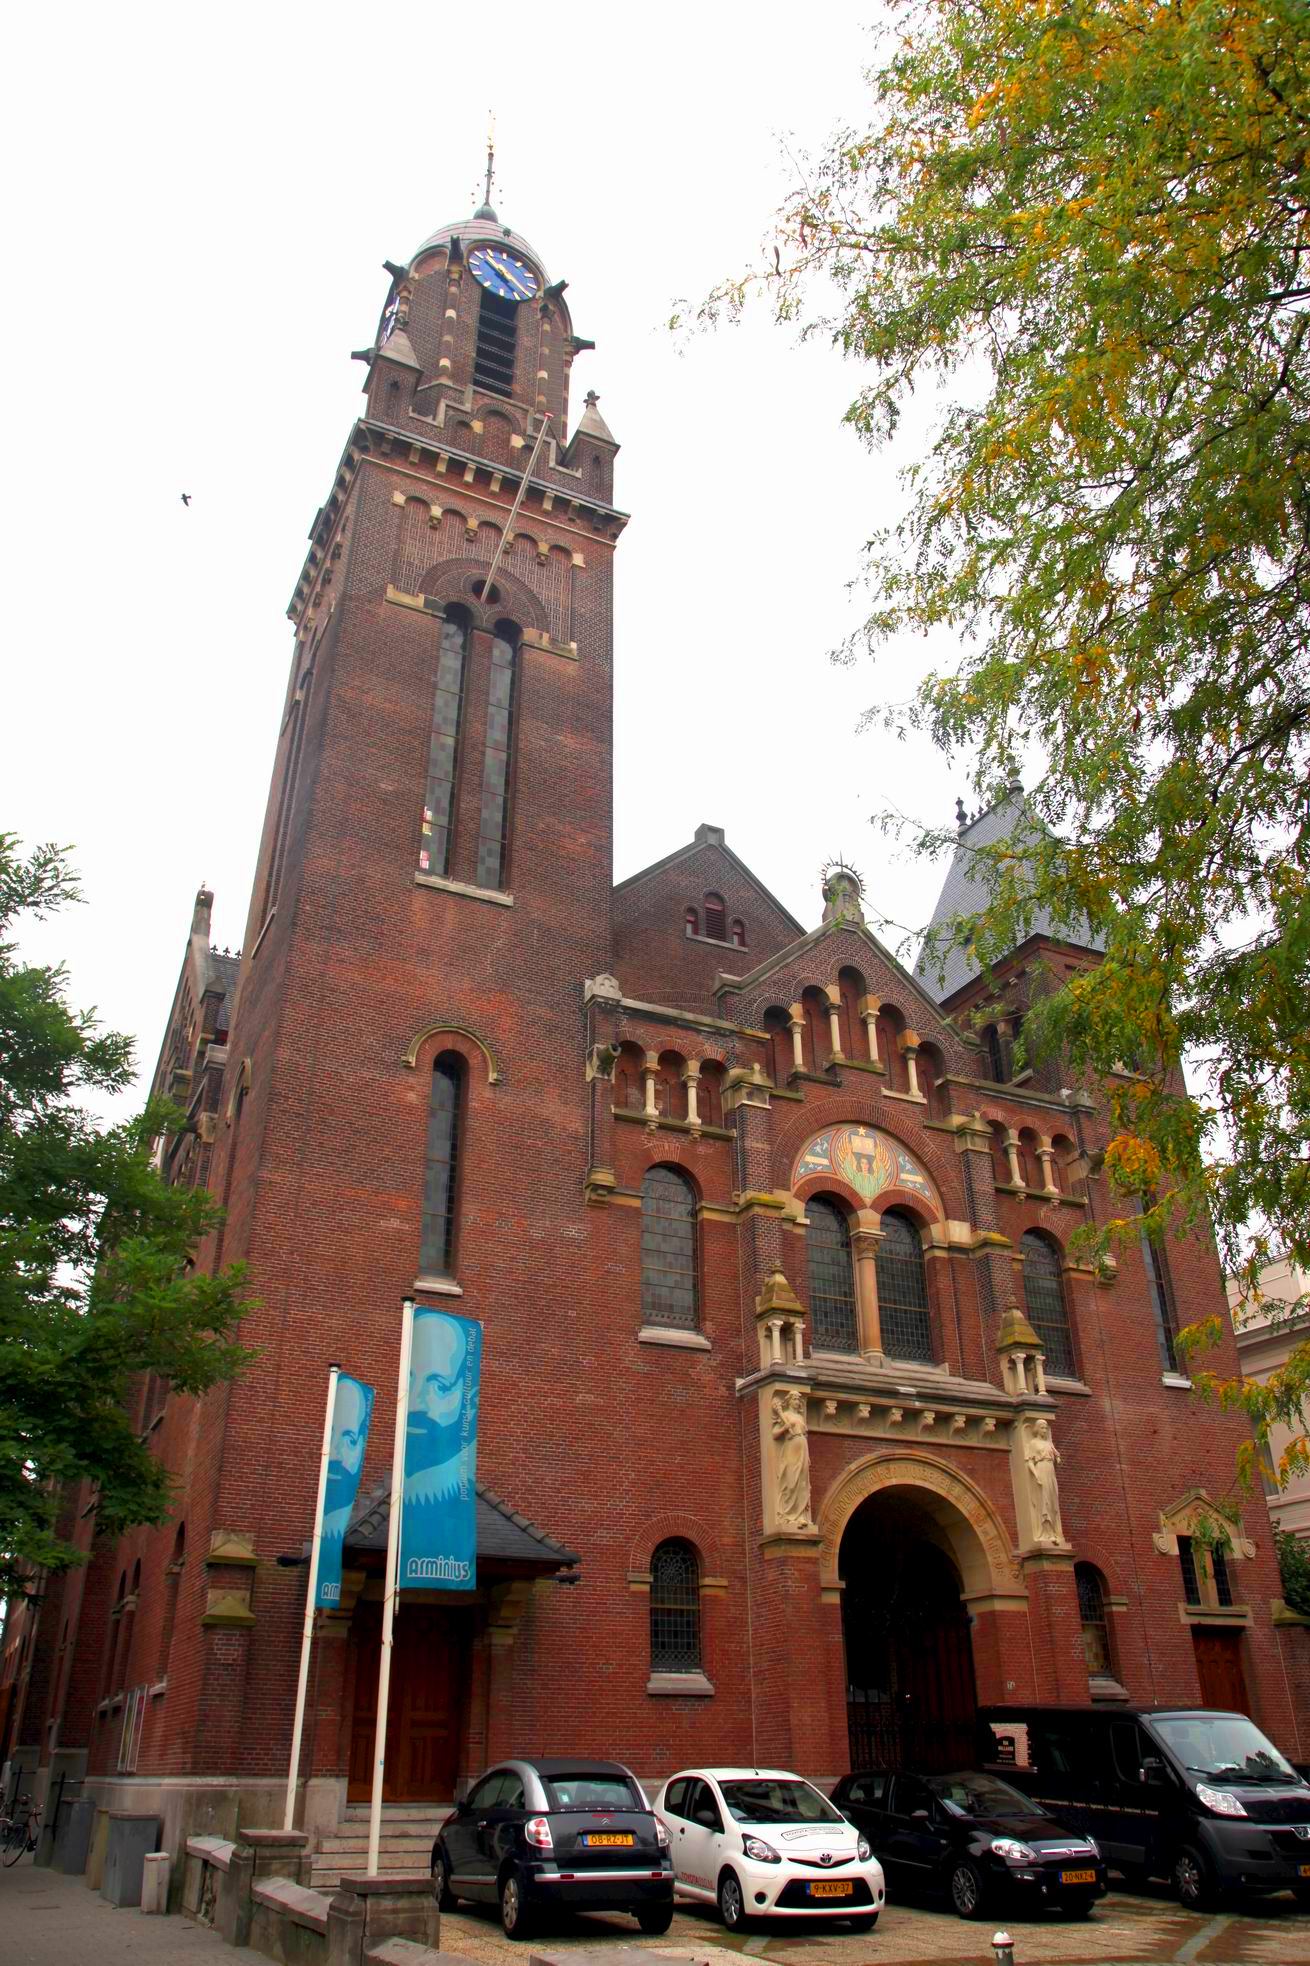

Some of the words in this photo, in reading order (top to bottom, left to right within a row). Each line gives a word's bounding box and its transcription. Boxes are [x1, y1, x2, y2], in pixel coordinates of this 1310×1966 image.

[467, 1328, 477, 1352] debat
[466, 1355, 474, 1367] en
[463, 1370, 473, 1405] cultuur
[407, 1555, 470, 1581] Arminius
